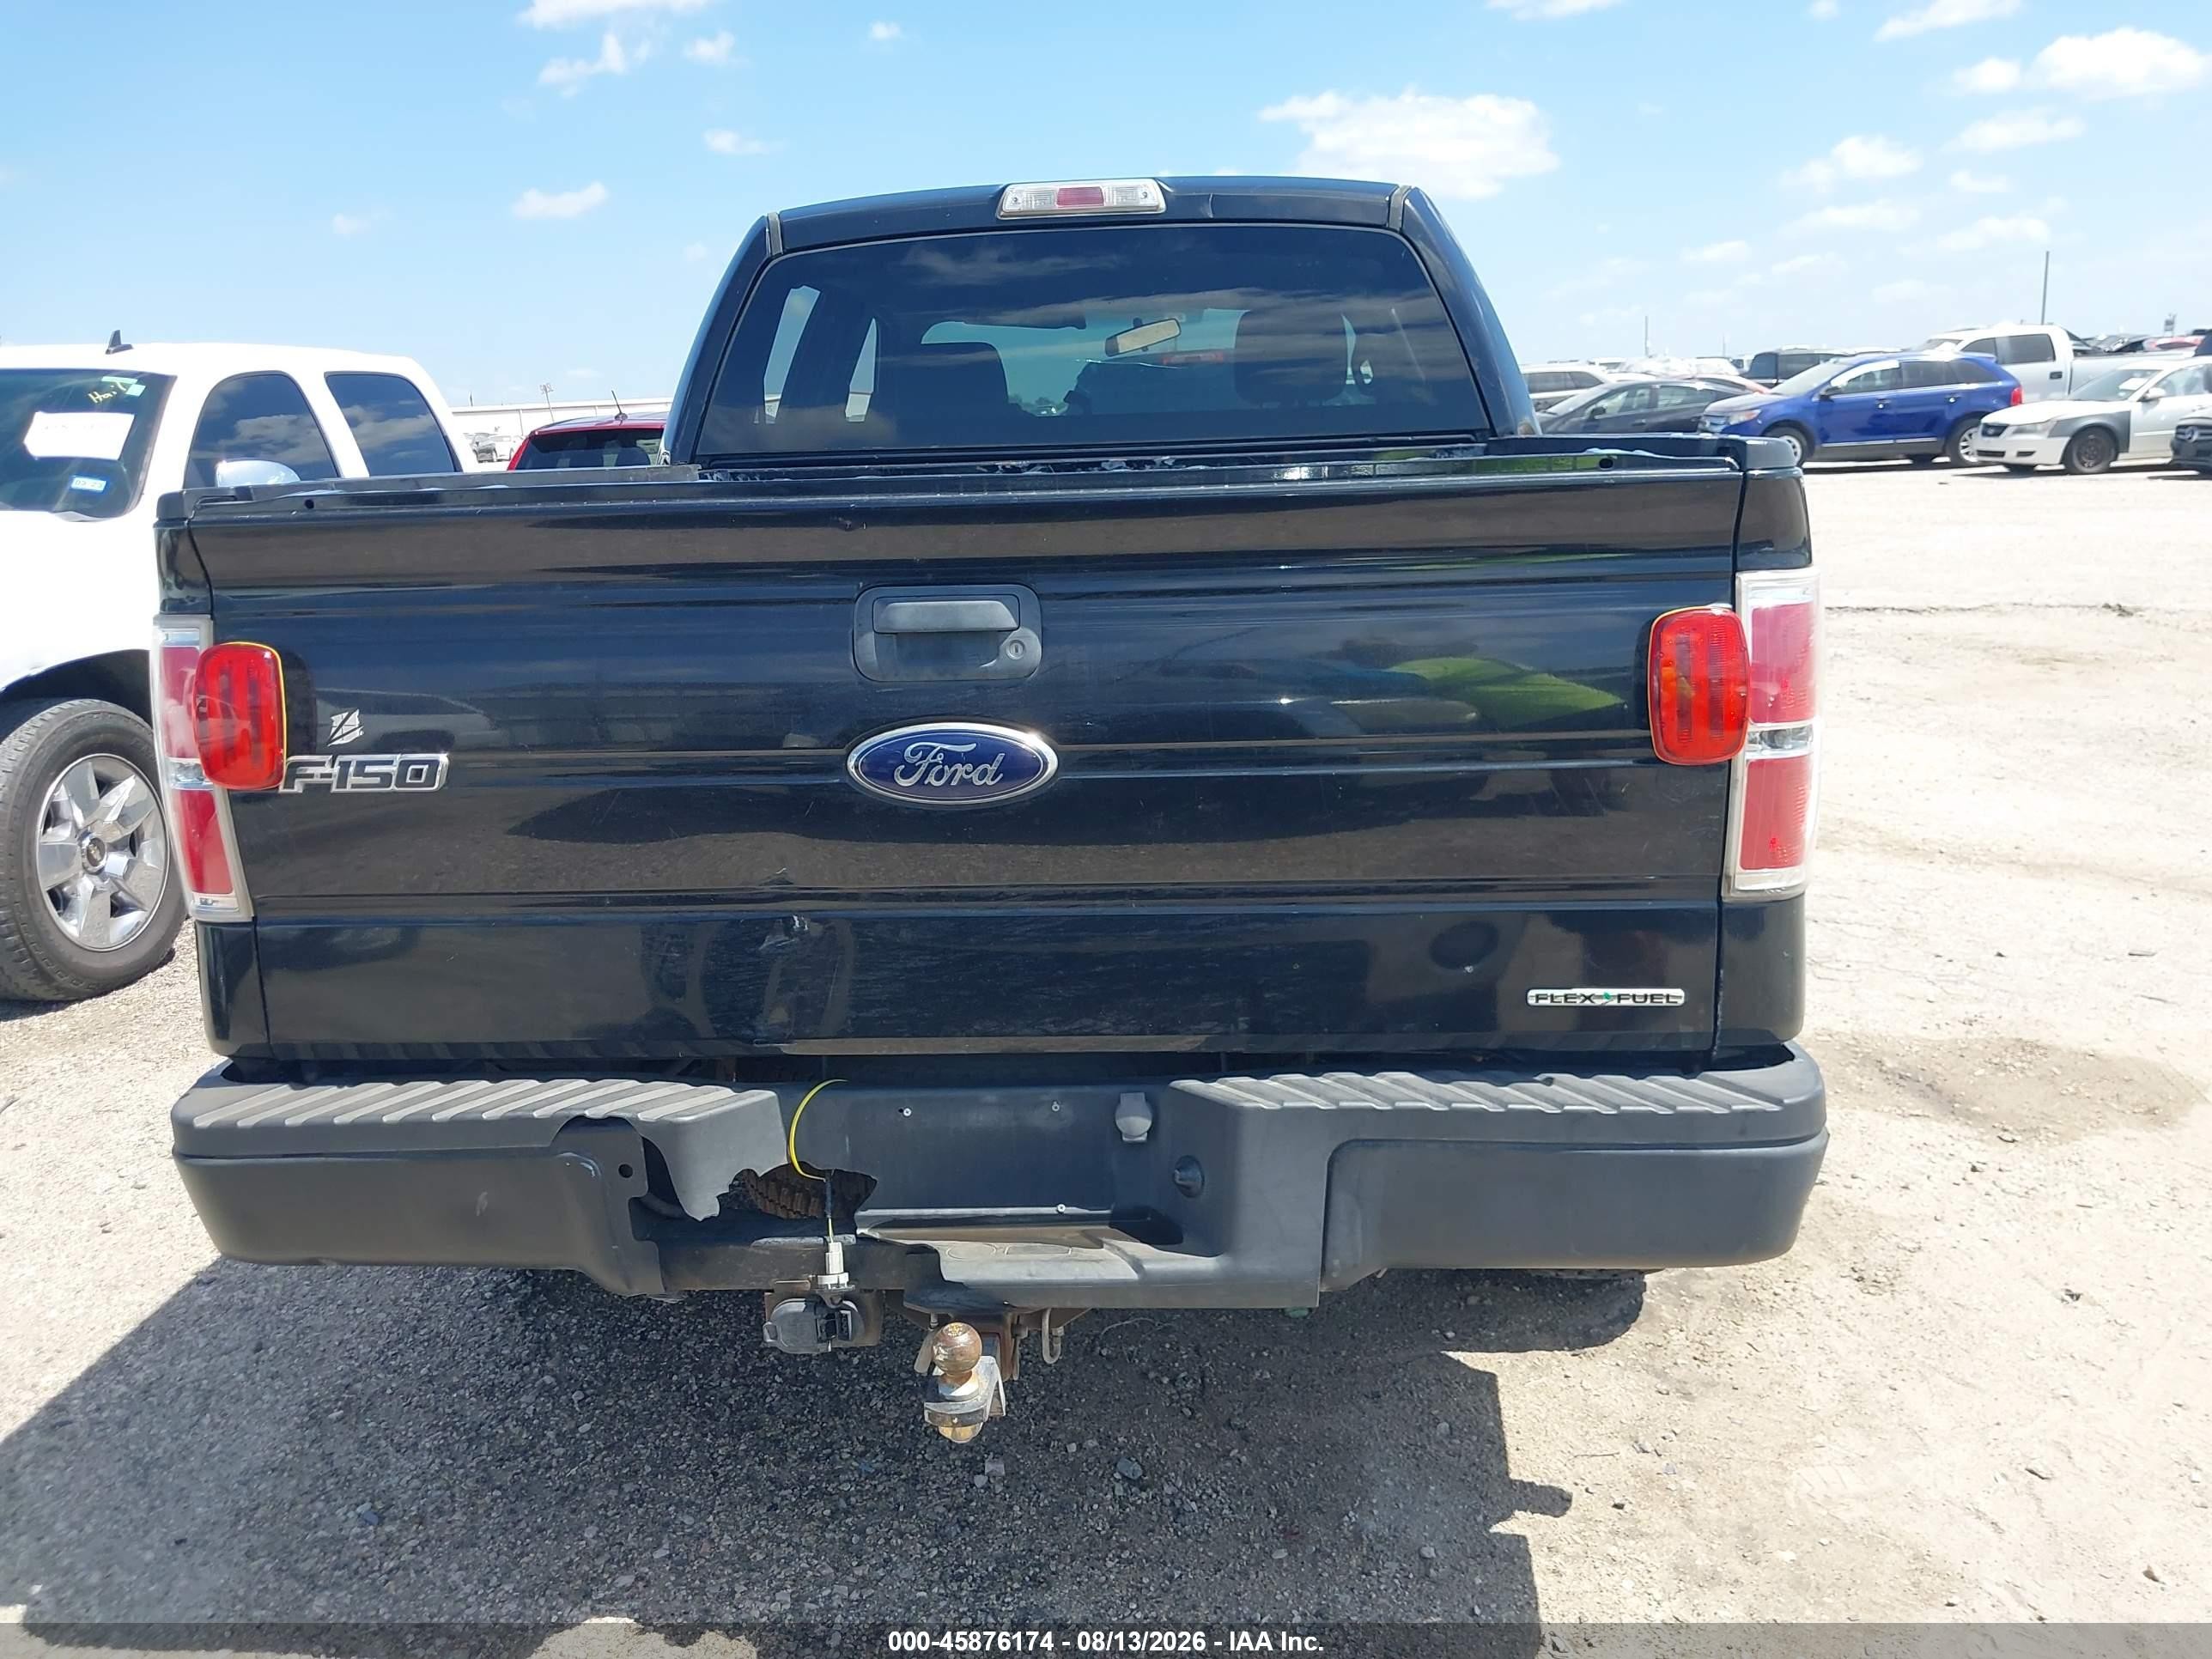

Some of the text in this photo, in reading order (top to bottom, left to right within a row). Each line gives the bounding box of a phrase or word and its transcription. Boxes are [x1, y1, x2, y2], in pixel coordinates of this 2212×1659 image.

[278, 752, 450, 793] F-150
[894, 742, 1006, 787] Ford
[1534, 993, 1679, 1004] FLEX FUEL
